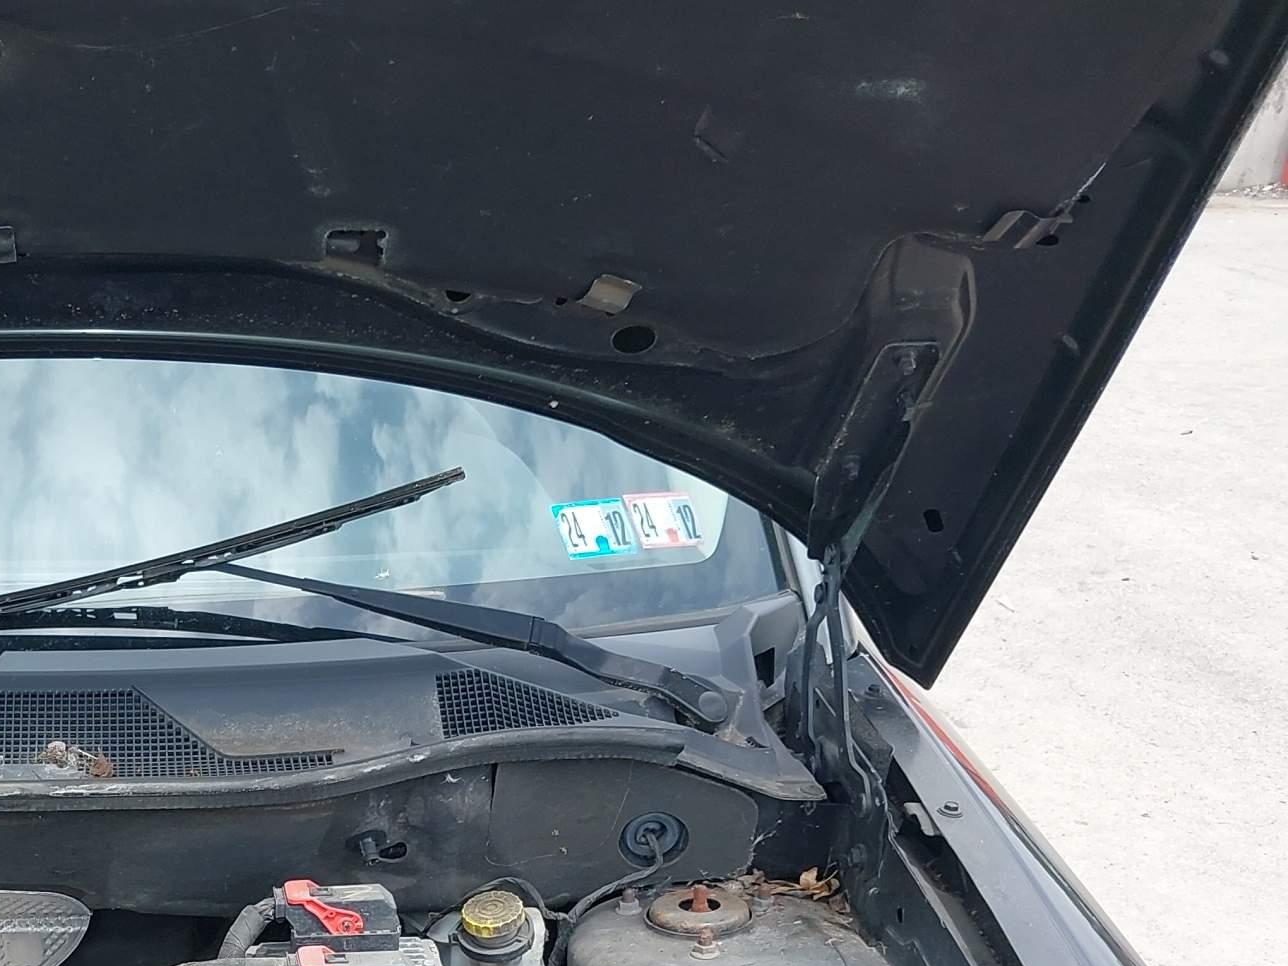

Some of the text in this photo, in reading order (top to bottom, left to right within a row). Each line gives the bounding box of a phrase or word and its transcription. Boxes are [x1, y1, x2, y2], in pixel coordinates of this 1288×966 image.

[561, 510, 632, 548] 24 12
[634, 502, 702, 540] 24 12
